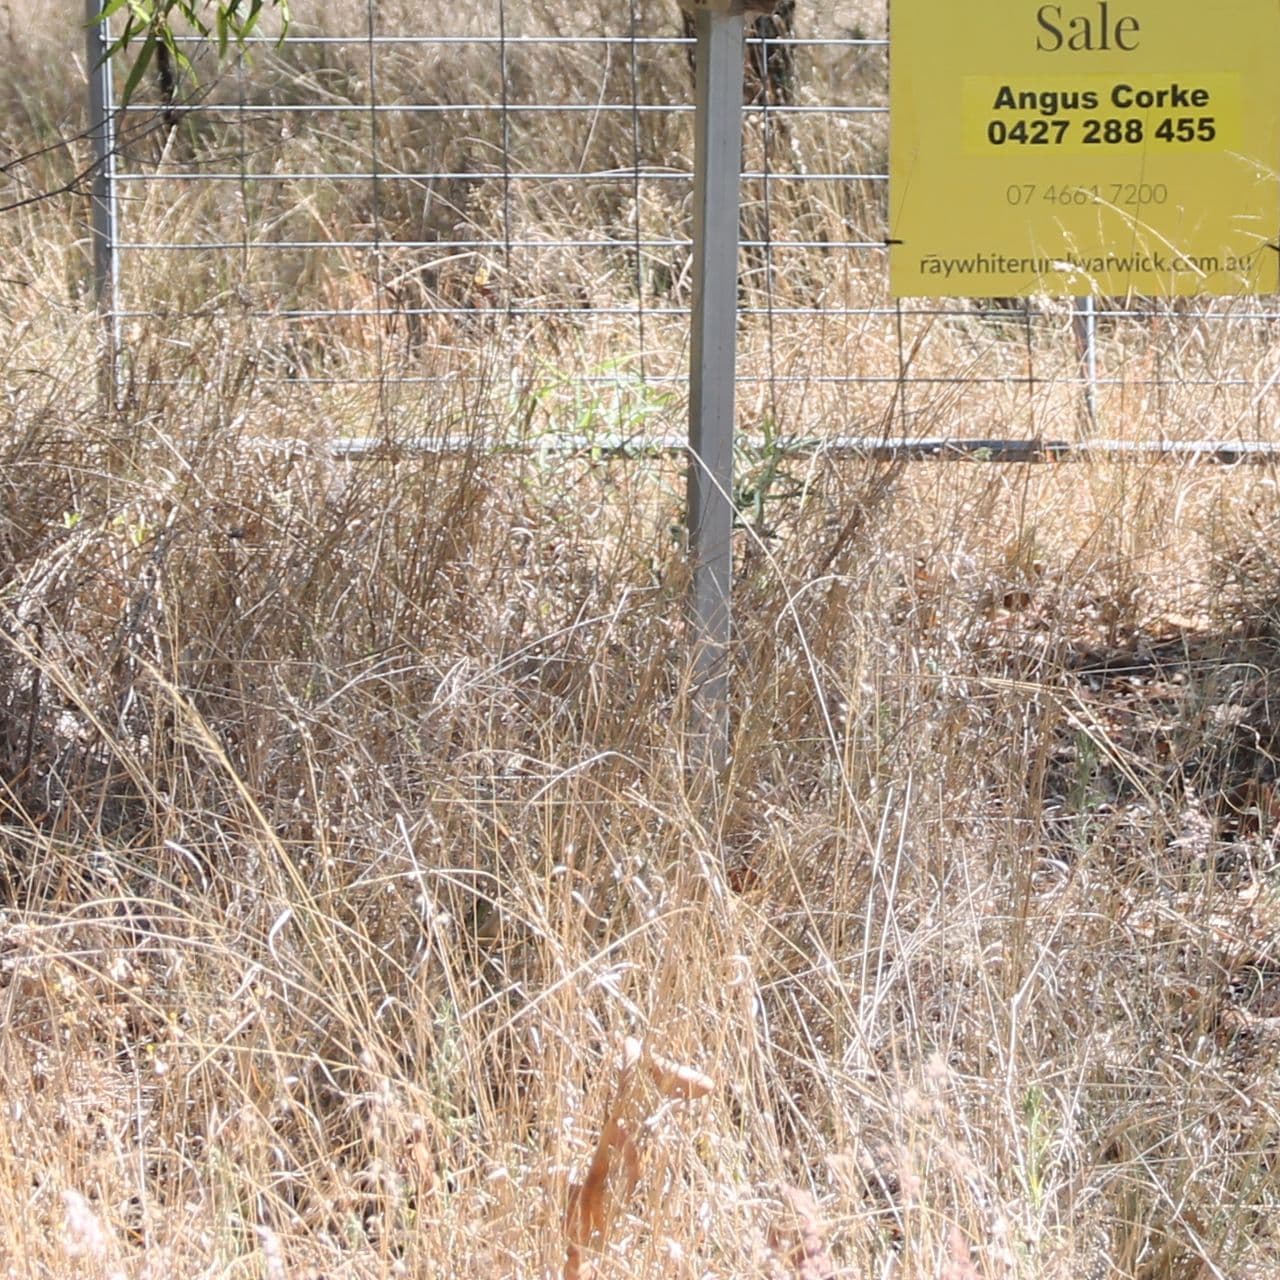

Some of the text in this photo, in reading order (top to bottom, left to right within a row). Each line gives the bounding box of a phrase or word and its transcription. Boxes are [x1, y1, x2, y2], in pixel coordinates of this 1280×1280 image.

[1036, 0, 1140, 52] Sale
[992, 84, 1210, 115] Angus Corke
[987, 117, 1217, 145] 0427 288 455
[1006, 183, 1168, 205] 07 4661 7200
